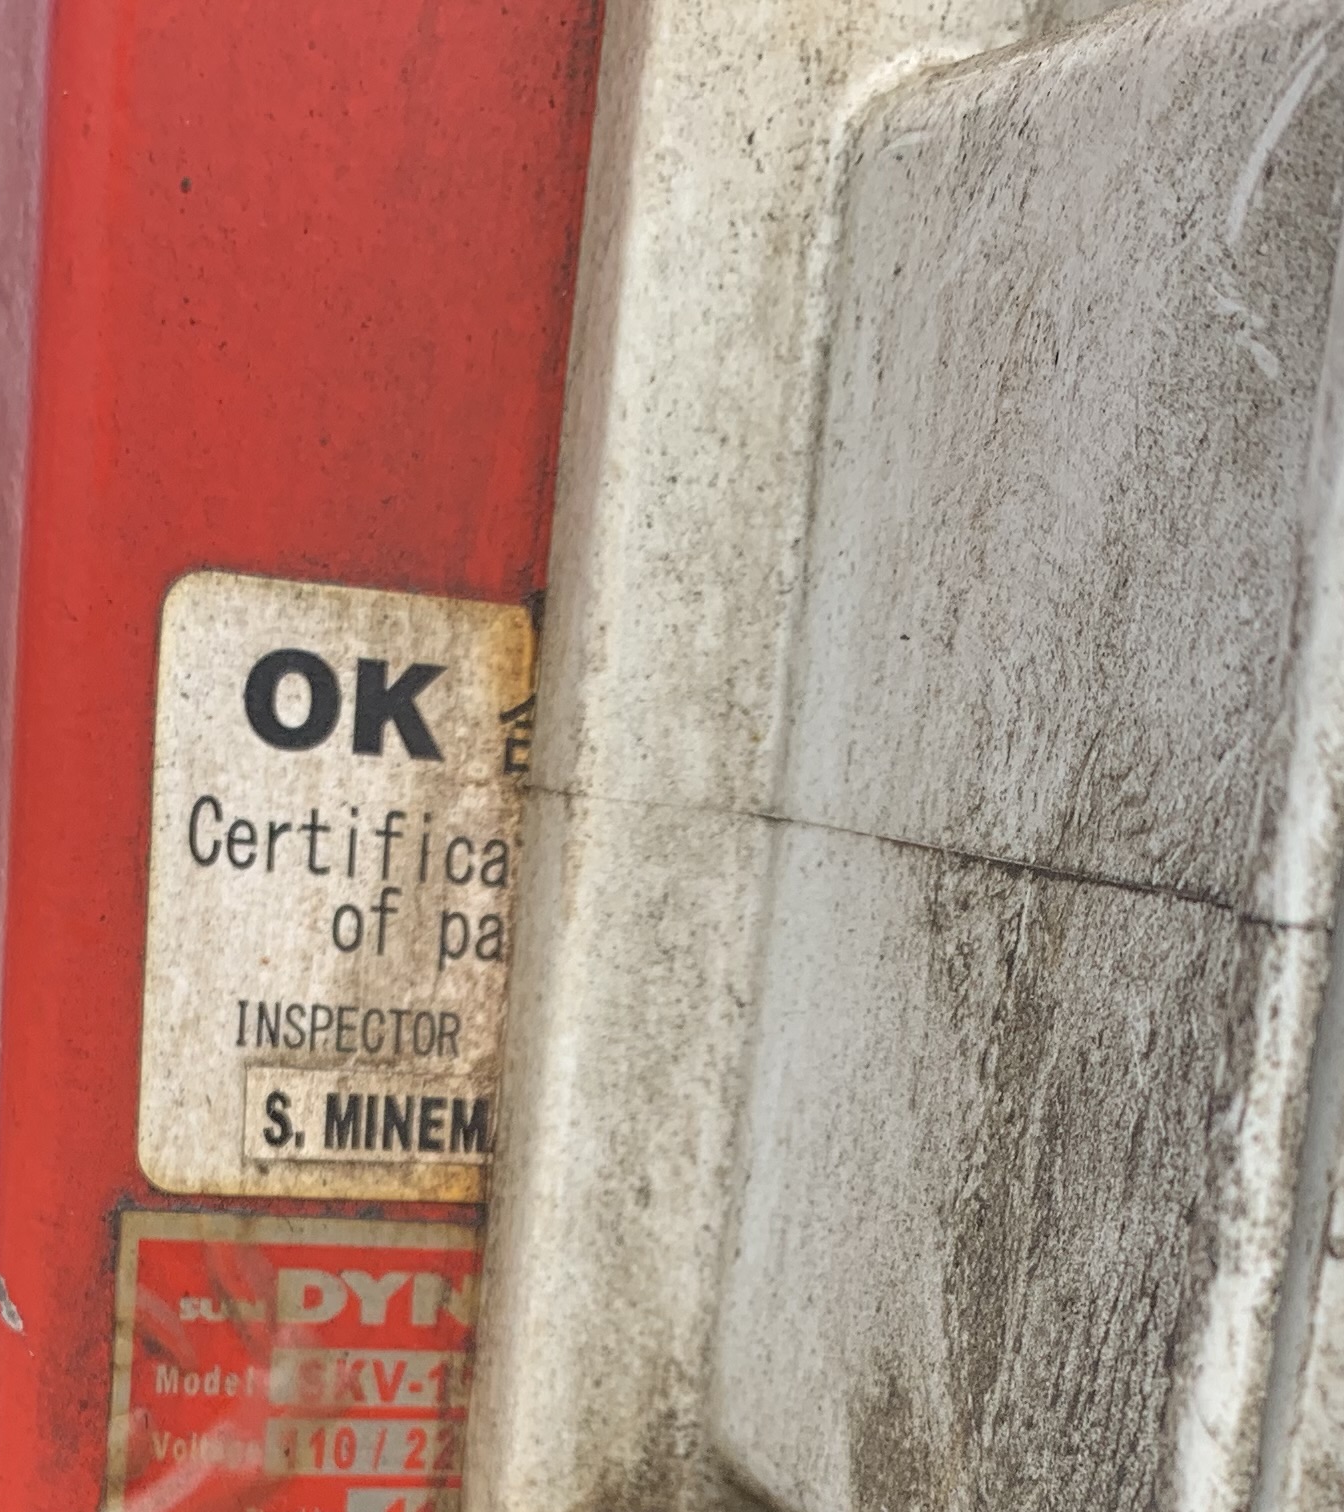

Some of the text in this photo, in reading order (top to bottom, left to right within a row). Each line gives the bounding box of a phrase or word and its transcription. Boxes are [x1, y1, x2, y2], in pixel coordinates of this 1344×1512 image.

[244, 648, 448, 762] OK
[188, 796, 509, 889] Certifica
[333, 888, 507, 971] of pa
[235, 1000, 462, 1058] INSPECTOR
[262, 1089, 495, 1153] S. MINEM
[156, 1363, 254, 1396] Model
